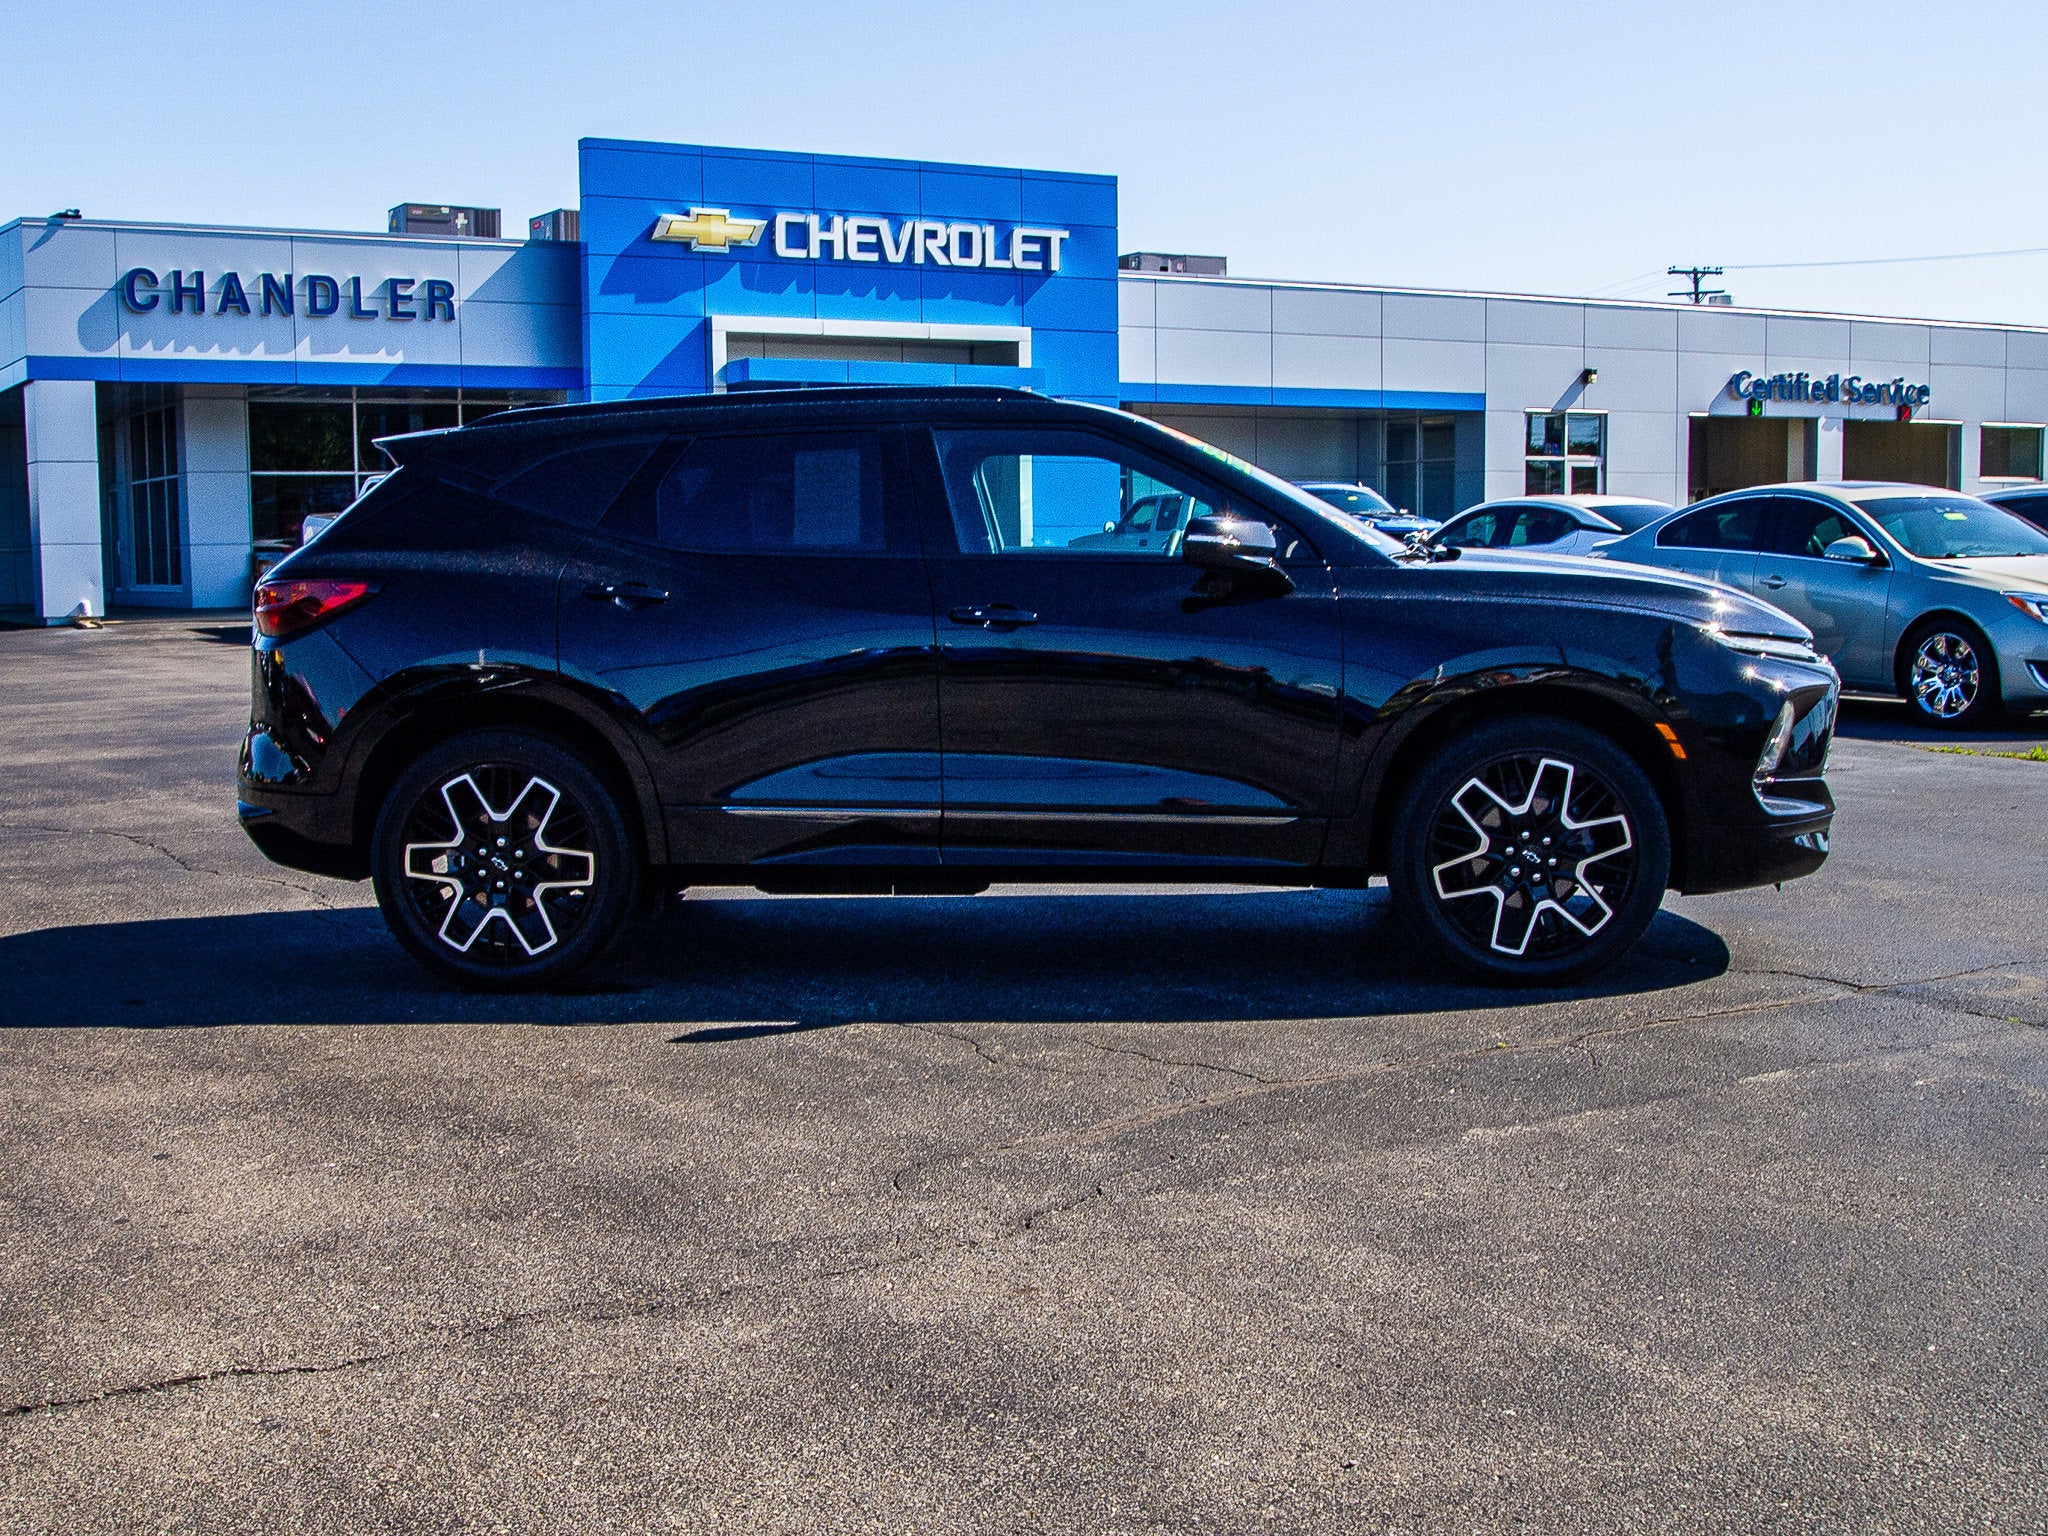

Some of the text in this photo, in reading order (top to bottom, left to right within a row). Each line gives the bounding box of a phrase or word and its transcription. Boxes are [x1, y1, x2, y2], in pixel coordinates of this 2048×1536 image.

[773, 211, 1070, 272] CHEVROLET
[123, 267, 456, 321] CHANDLER
[1733, 370, 1930, 406] Certified Service
